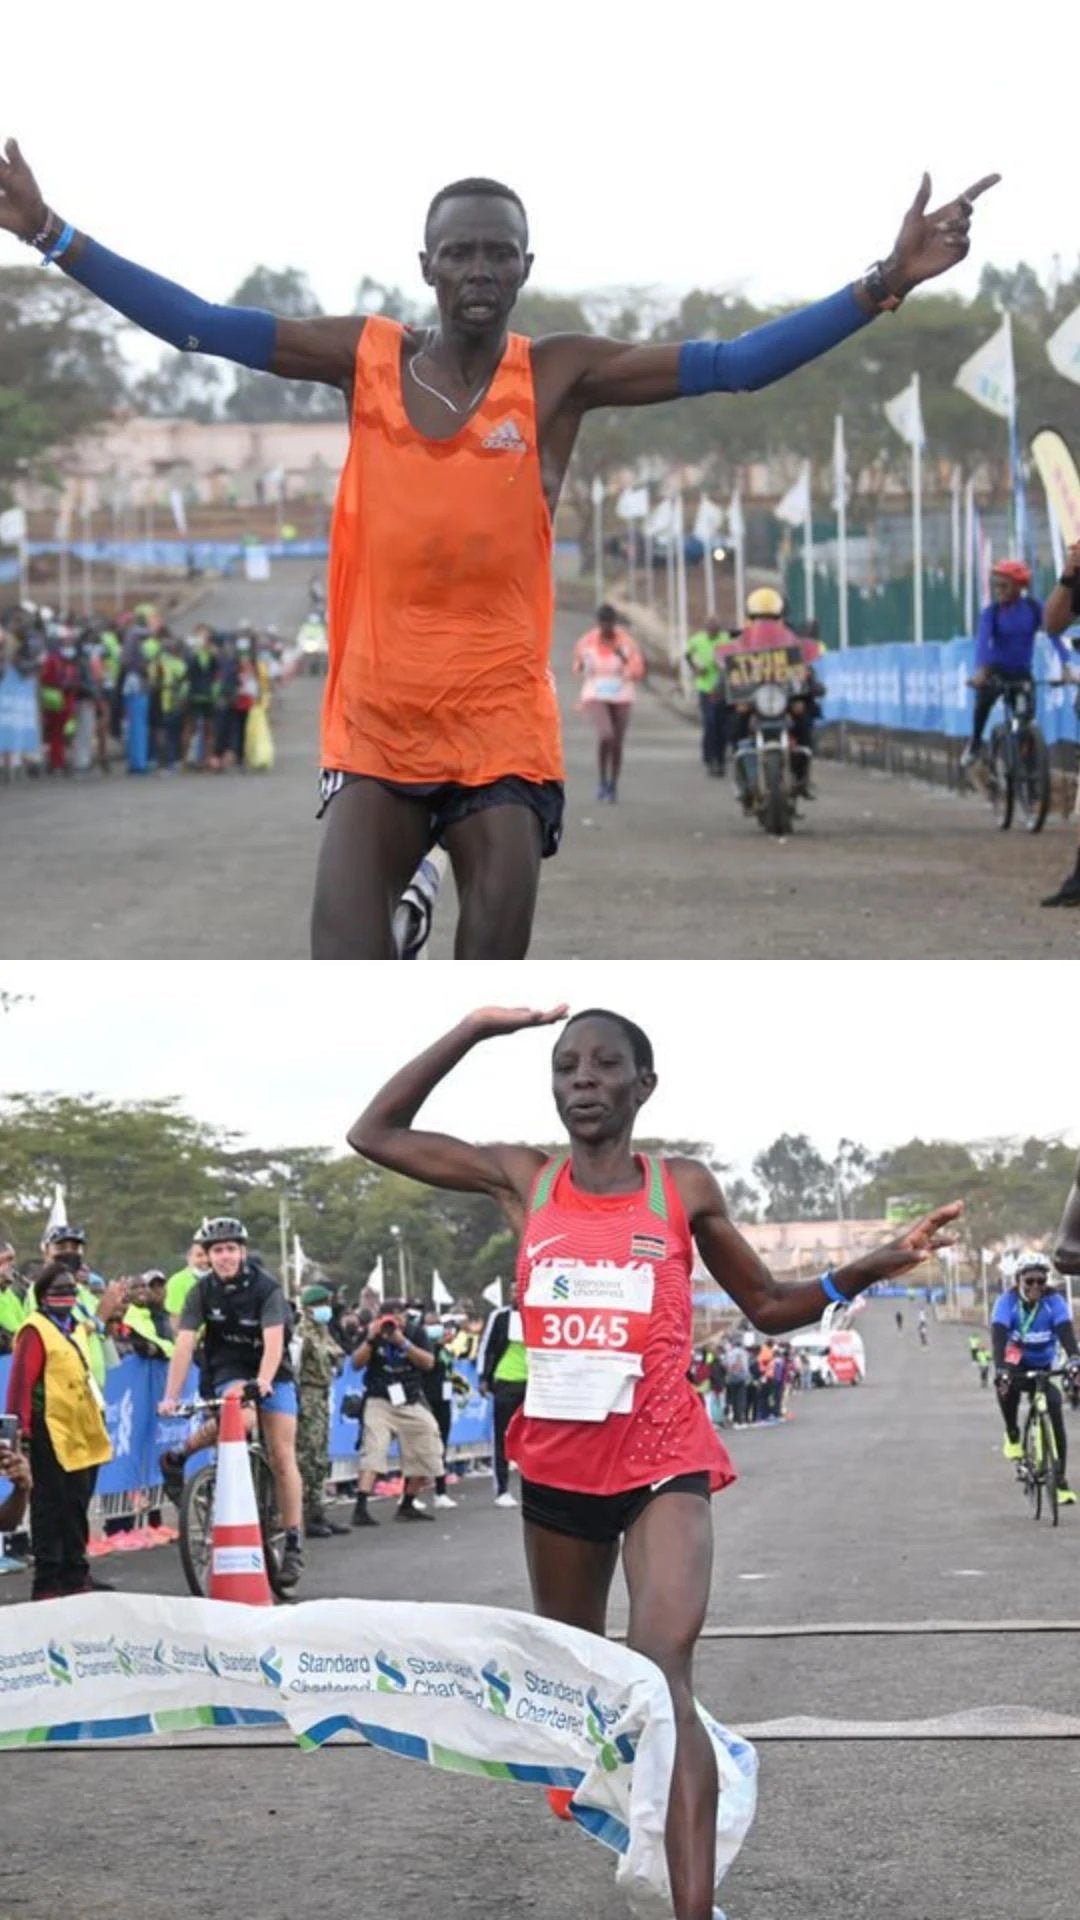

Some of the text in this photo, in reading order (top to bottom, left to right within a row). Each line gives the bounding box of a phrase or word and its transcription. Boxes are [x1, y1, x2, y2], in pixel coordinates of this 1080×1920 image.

[541, 1314, 629, 1347] 3045
[298, 1651, 371, 1673] Standard
[523, 1669, 585, 1708] Standard
